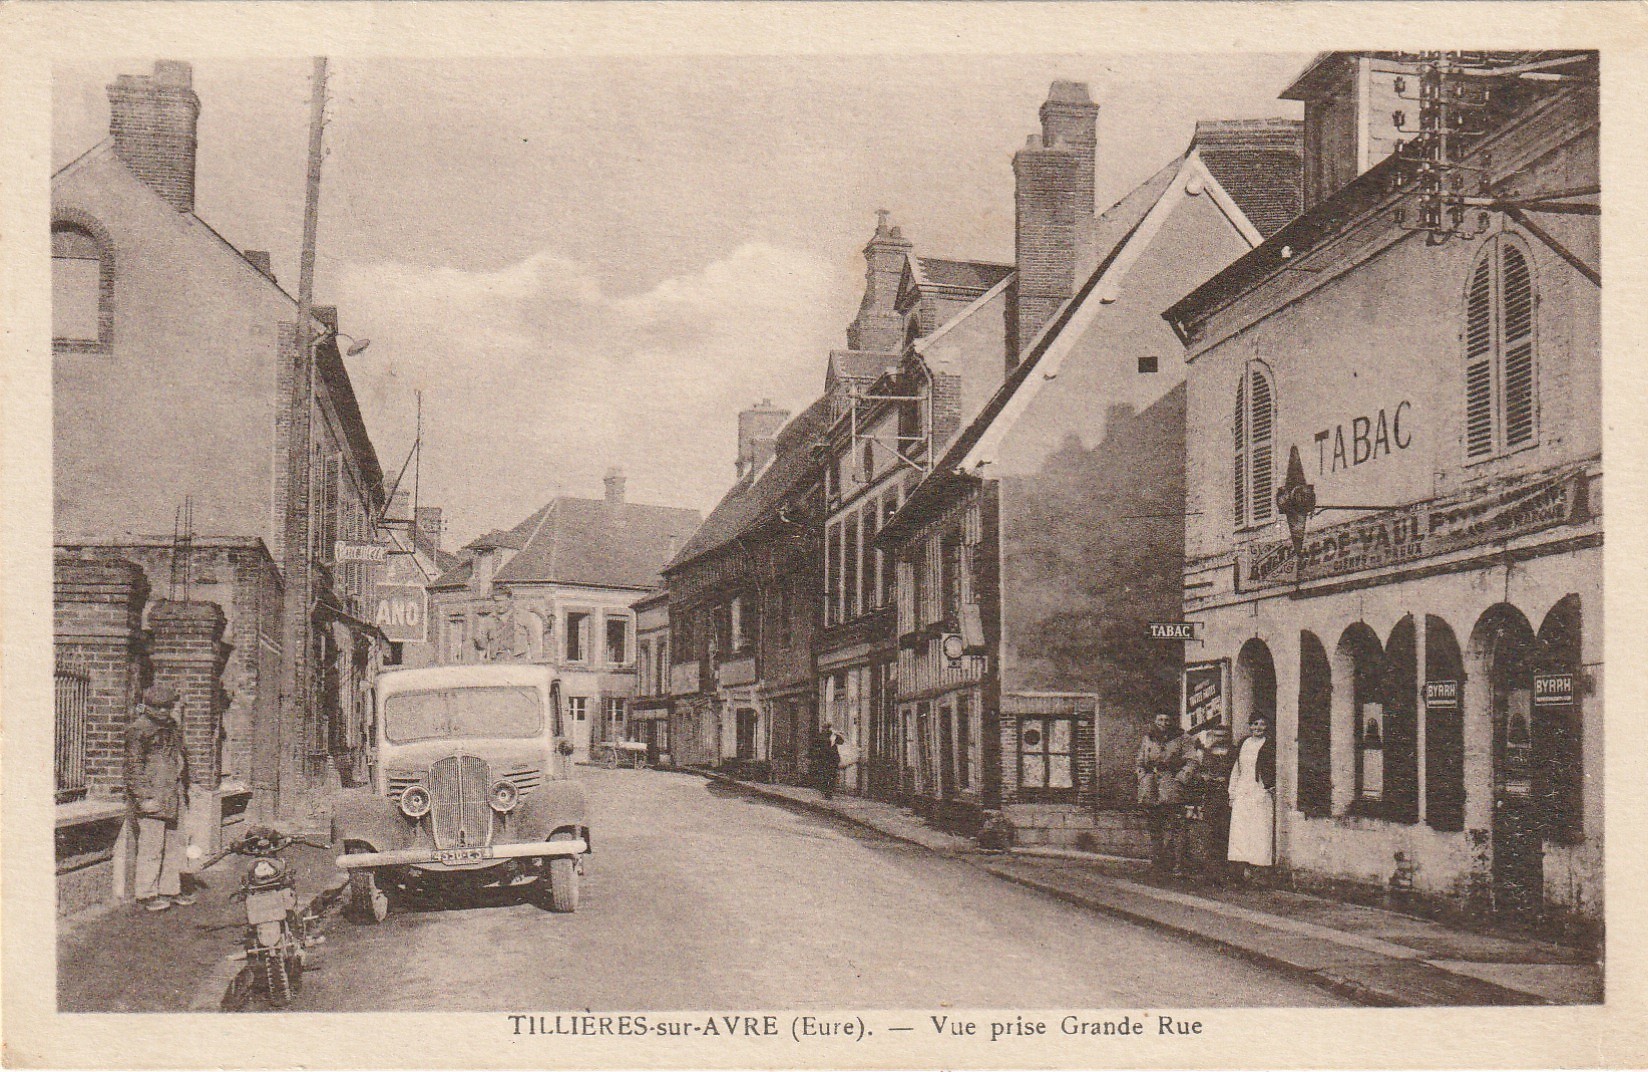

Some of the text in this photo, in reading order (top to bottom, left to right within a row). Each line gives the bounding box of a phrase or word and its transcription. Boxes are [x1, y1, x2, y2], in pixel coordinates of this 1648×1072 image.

[1314, 400, 1412, 475] TABAC
[1150, 624, 1190, 638] TABAC
[1427, 683, 1456, 699] BYRRH
[1536, 677, 1572, 694] BYRRH
